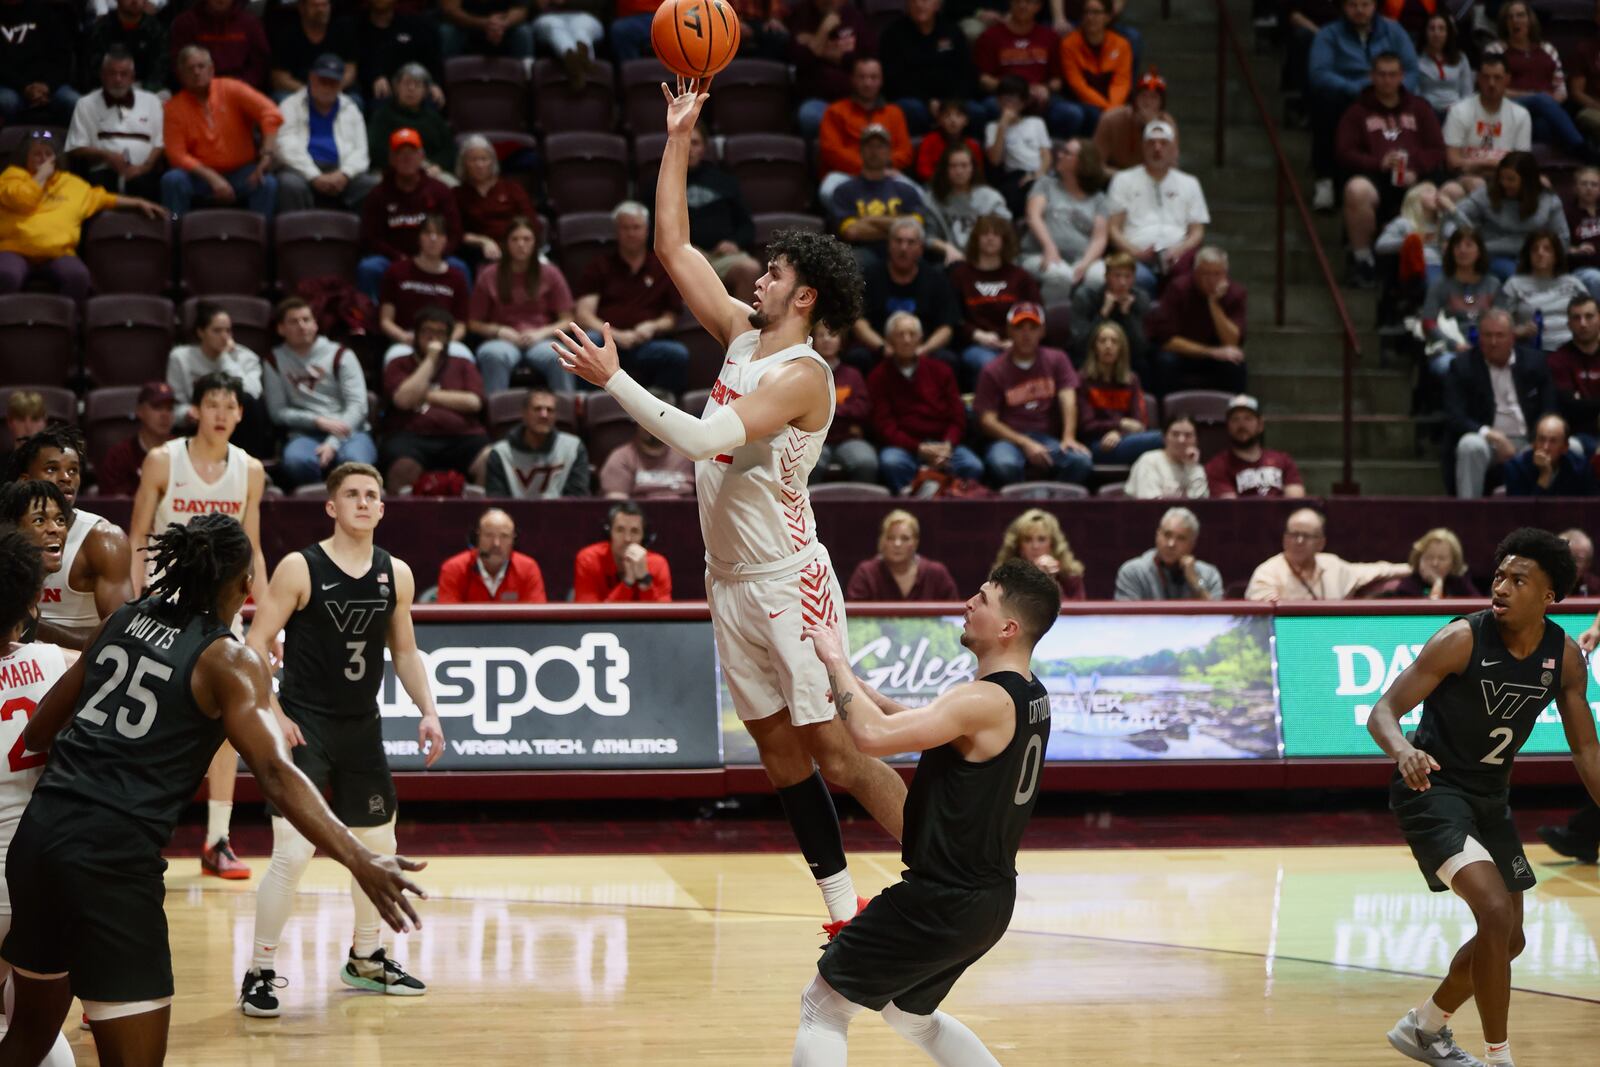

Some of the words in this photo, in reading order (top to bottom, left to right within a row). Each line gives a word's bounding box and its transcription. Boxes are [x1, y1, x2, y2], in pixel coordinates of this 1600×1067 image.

[173, 499, 241, 514] DAYTON
[124, 612, 181, 650] MUTTS
[324, 600, 388, 634] VT
[344, 641, 367, 681] 3
[77, 644, 173, 739] 25
[1480, 679, 1548, 719] VT
[452, 739, 533, 755] VIRGINIA
[592, 738, 678, 754] ATHLETICS
[1480, 727, 1514, 765] 2
[1014, 733, 1042, 806] 0
